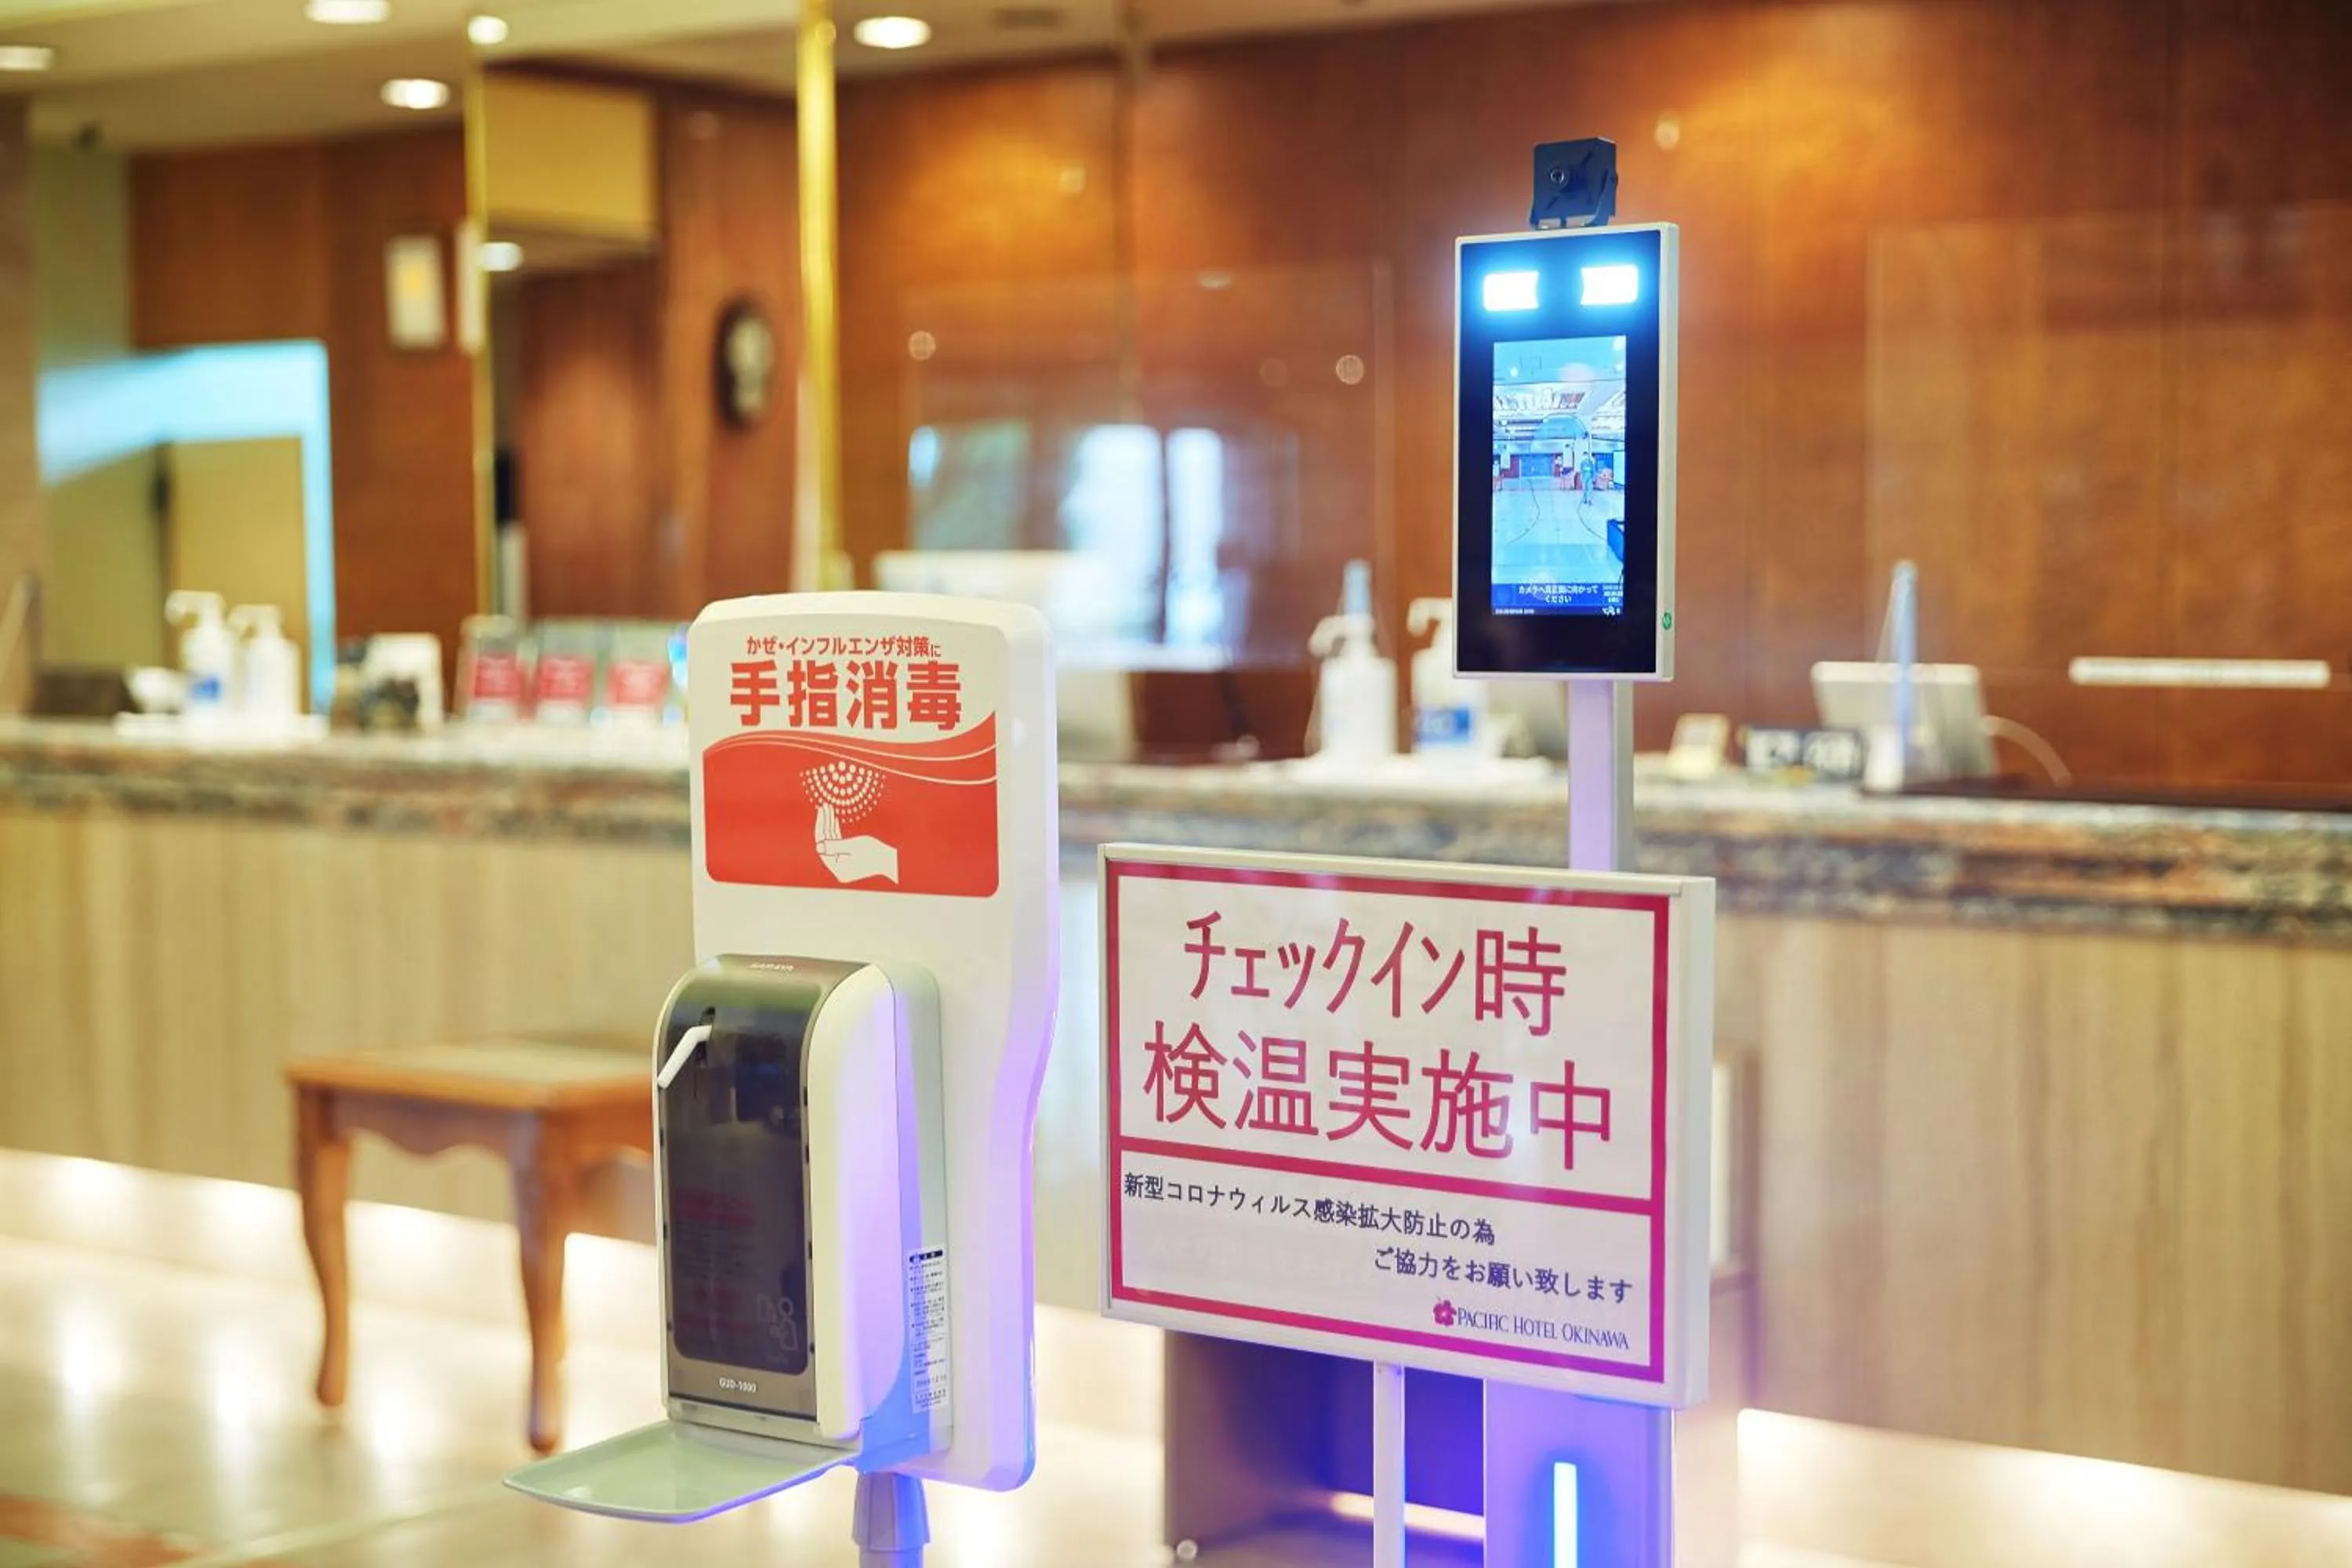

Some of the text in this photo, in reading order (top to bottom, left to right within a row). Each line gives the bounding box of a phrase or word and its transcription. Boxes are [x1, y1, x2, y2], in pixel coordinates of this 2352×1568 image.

[746, 635, 941, 658] かぜ・インフルエンザ対策に
[730, 659, 962, 730] 手指消毒
[1183, 910, 1567, 1036] チェックイン時
[1142, 1020, 1612, 1171] 検温実施中
[1123, 1171, 1496, 1246] 新型コロナウィルス感染拡大防止の為
[1374, 1247, 1633, 1304] ご協力をお願い致します
[1457, 1307, 1630, 1350] PACIFIC HOTEL OKINAWA
